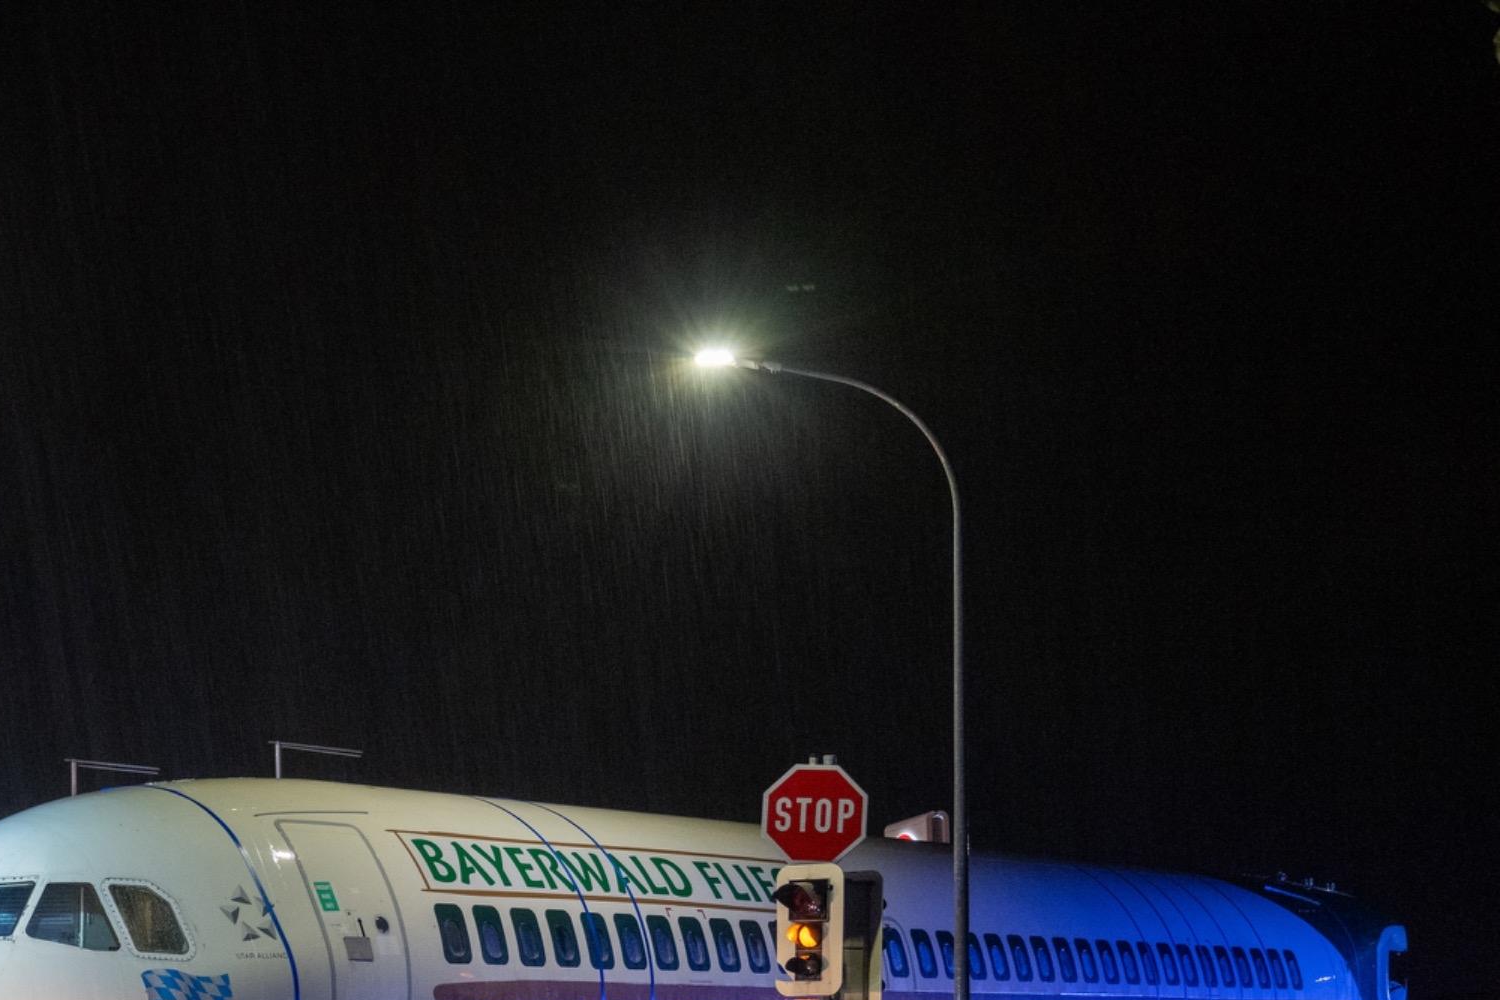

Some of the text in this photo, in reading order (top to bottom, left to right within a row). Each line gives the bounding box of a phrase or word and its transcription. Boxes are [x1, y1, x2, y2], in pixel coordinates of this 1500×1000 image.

[774, 797, 855, 834] STOP
[411, 838, 780, 903] BAYERWALD FLIE
[257, 952, 288, 960] ALLIANC
